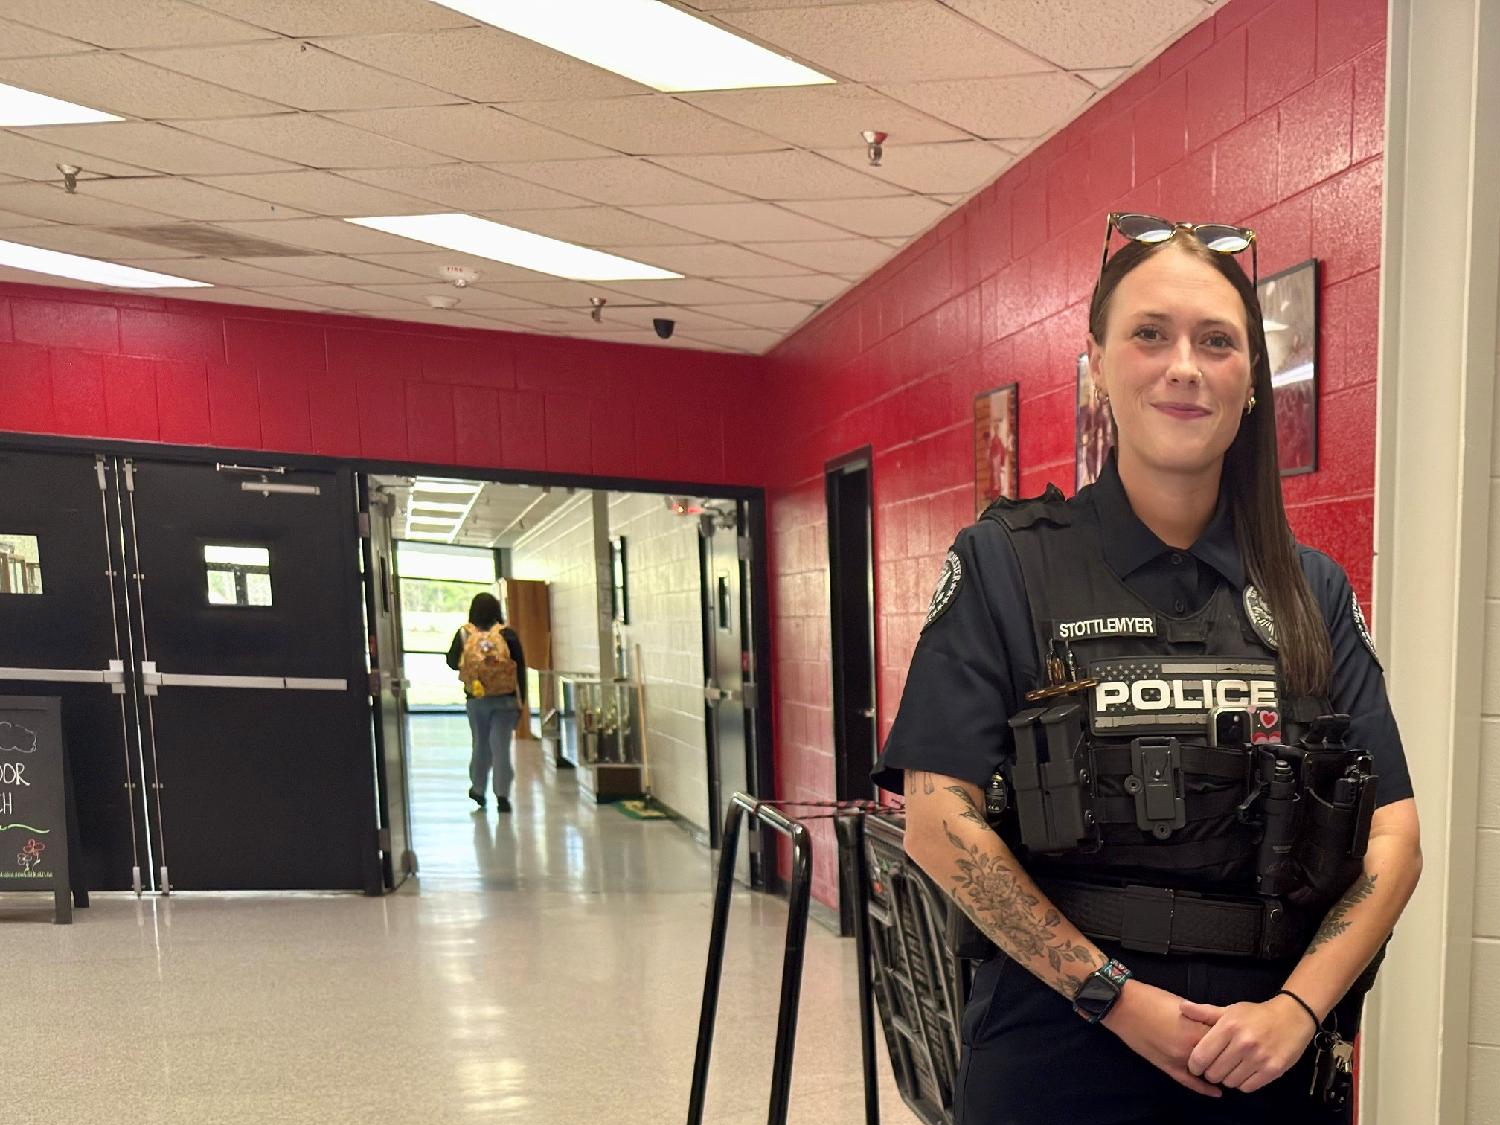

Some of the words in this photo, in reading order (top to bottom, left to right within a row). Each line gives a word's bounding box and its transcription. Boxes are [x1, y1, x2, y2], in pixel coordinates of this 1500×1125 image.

[1059, 617, 1154, 638] STOTTLEMYER
[1095, 679, 1277, 712] POLICE
[0, 762, 31, 786] OR
